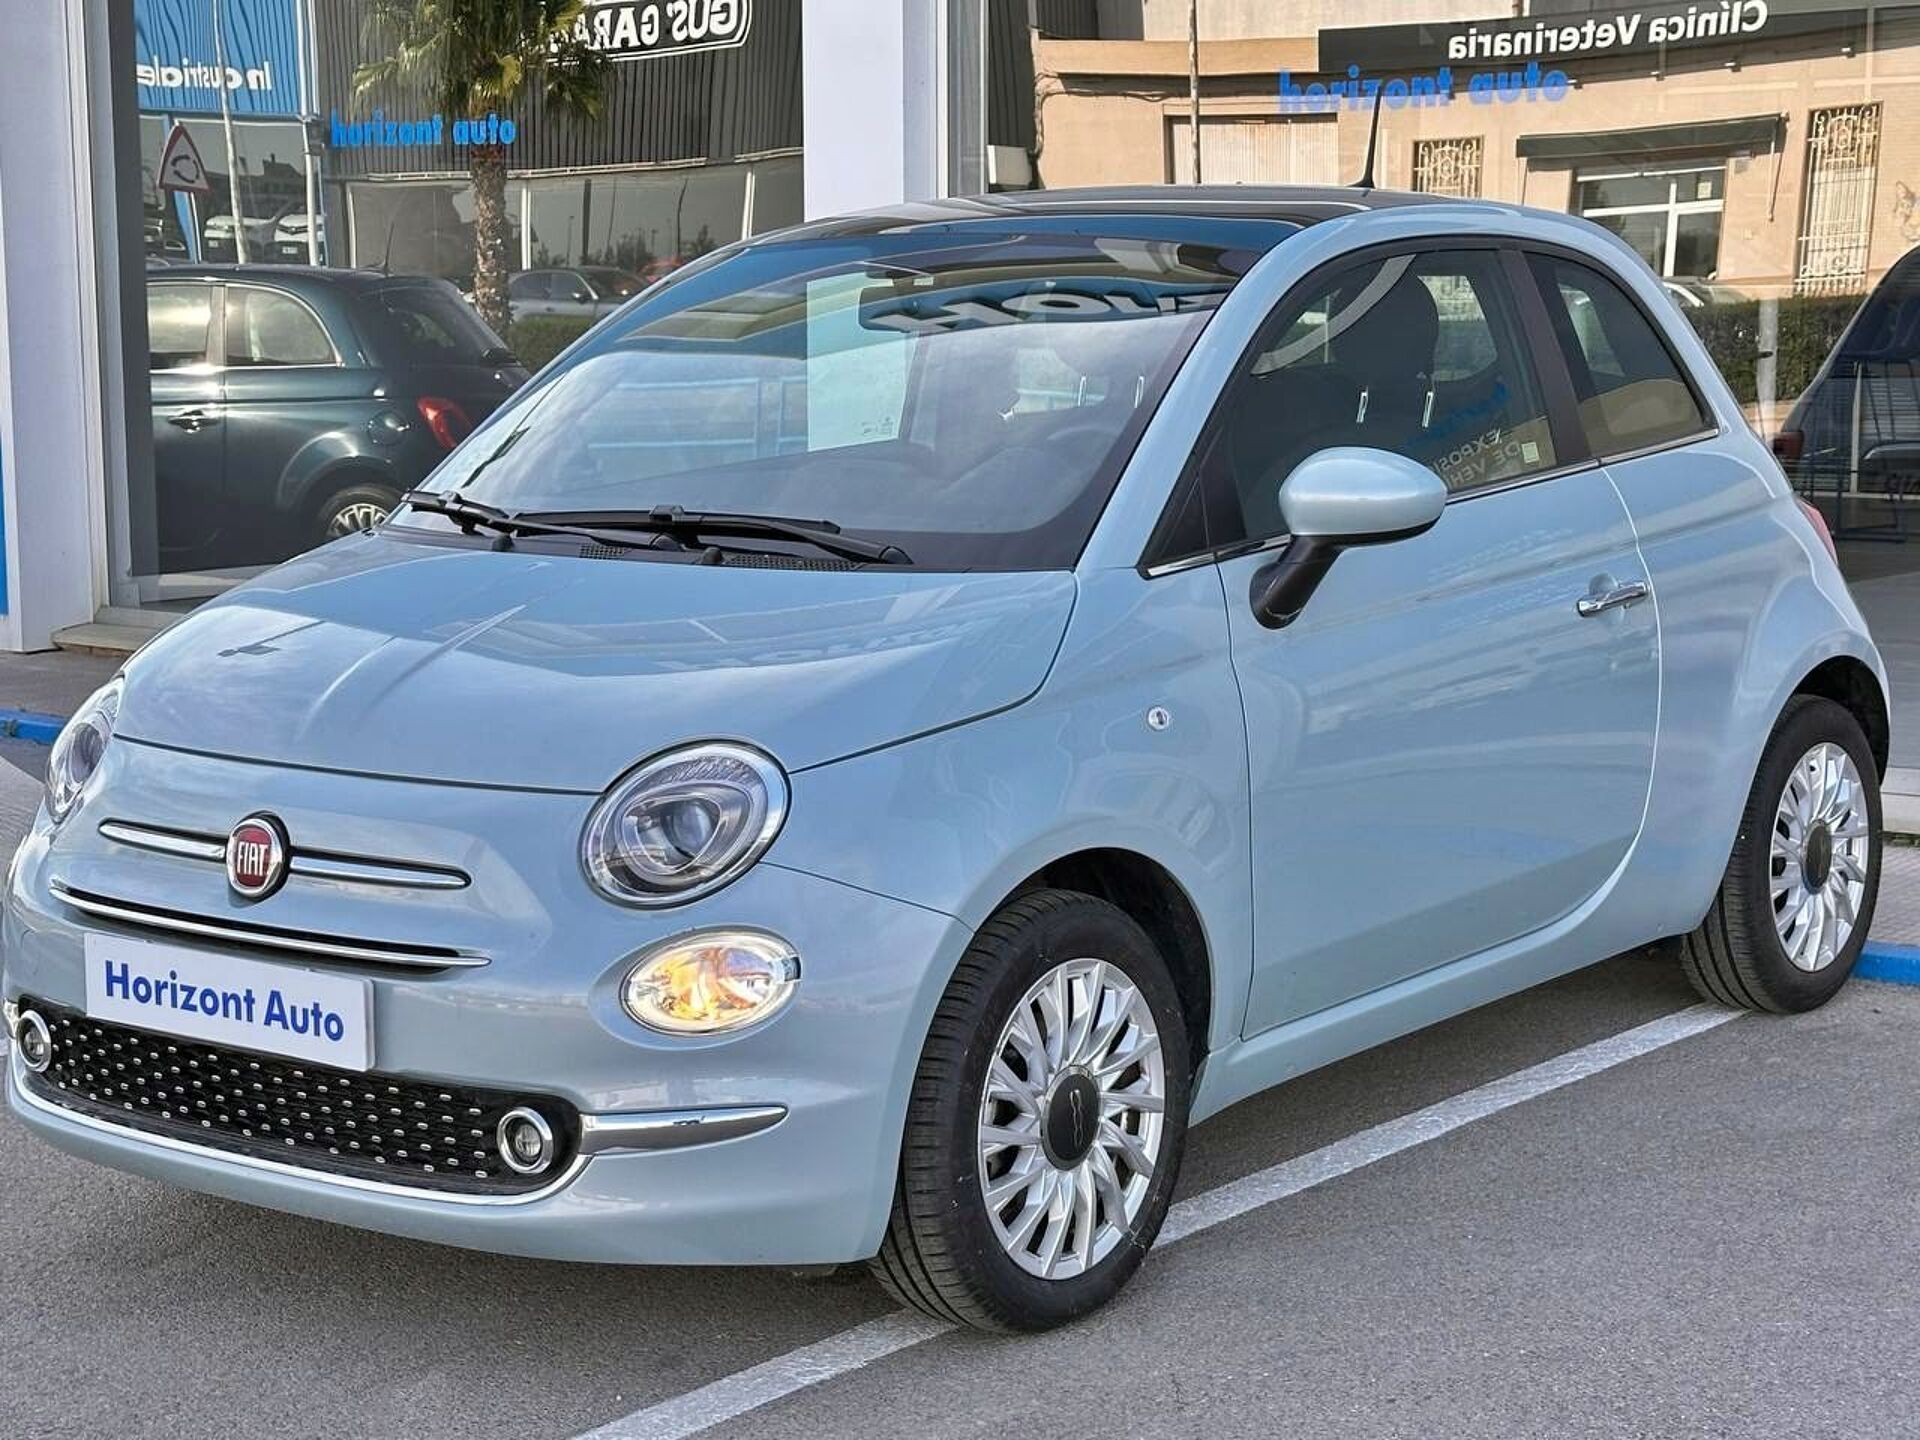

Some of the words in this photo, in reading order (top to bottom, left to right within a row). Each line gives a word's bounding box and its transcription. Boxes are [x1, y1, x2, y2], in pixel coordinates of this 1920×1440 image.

[1278, 64, 1453, 112] horizont
[1468, 61, 1568, 104] auto
[330, 107, 443, 147] horizont
[452, 112, 516, 145] auto
[237, 841, 269, 876] FIAT
[105, 960, 256, 1023] Horizont
[264, 989, 344, 1042] Auto
